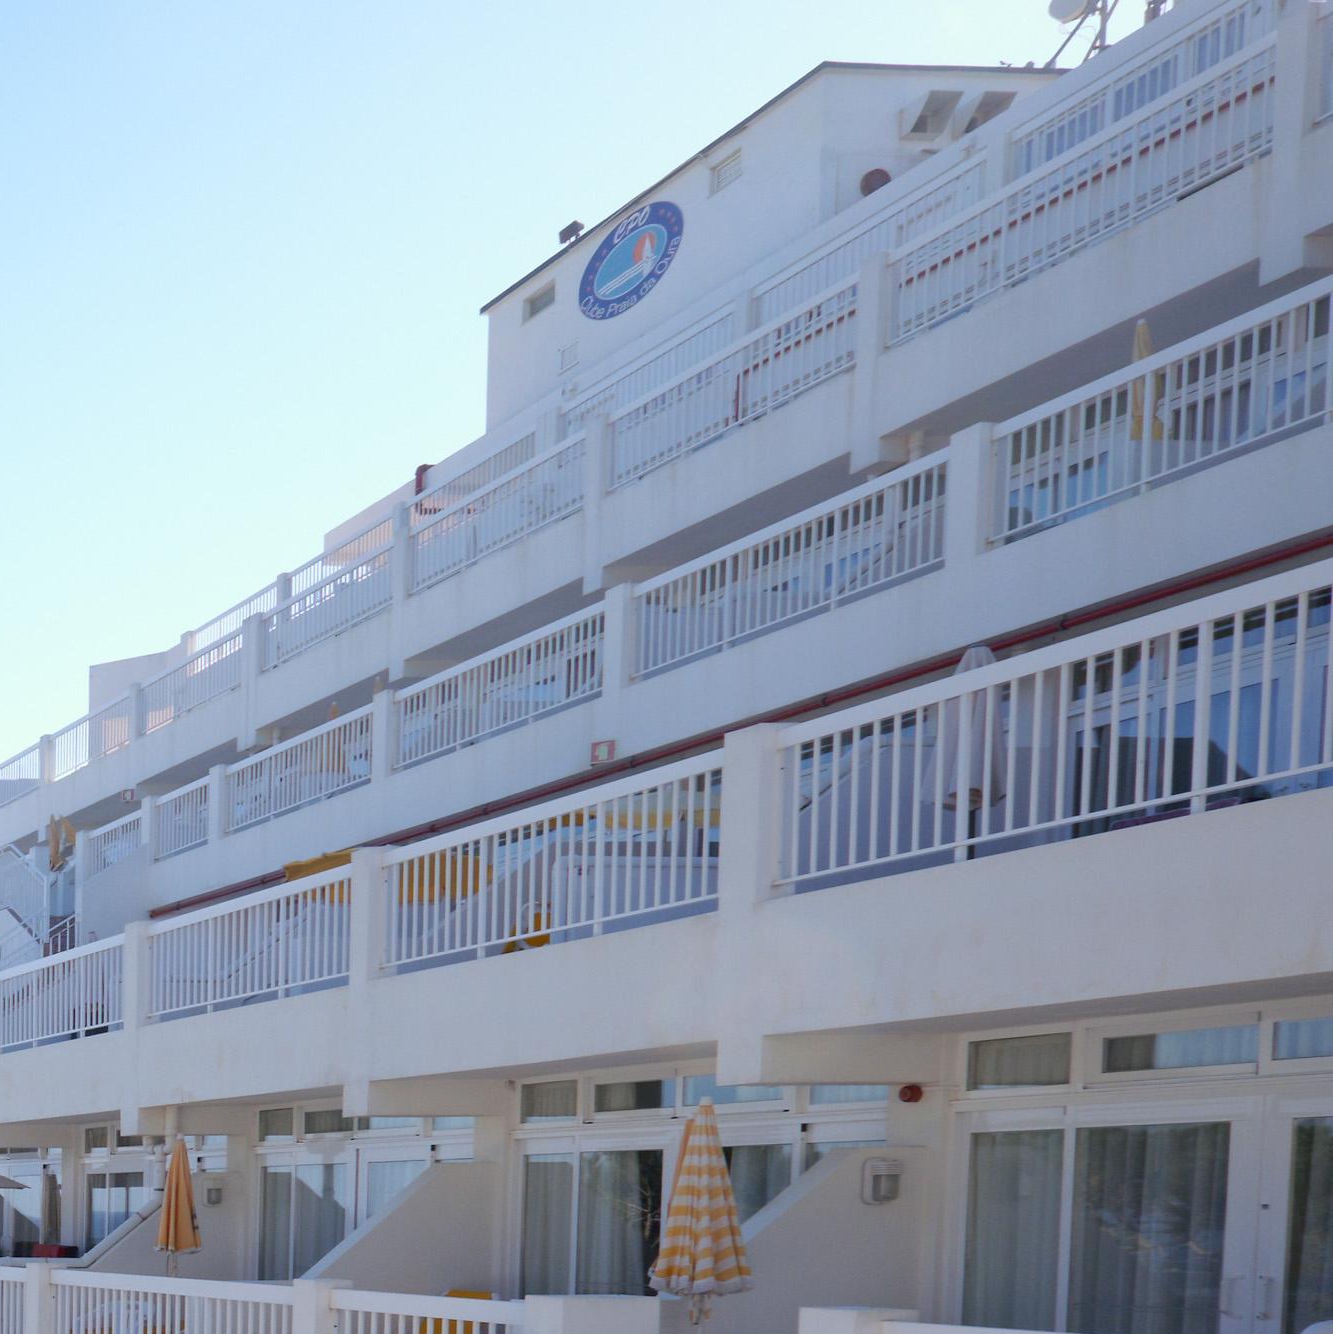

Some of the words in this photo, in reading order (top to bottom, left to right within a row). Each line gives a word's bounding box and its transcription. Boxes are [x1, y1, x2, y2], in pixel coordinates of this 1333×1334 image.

[606, 295, 637, 317] Praia
[639, 277, 656, 296] da
[655, 236, 680, 274] Oura
